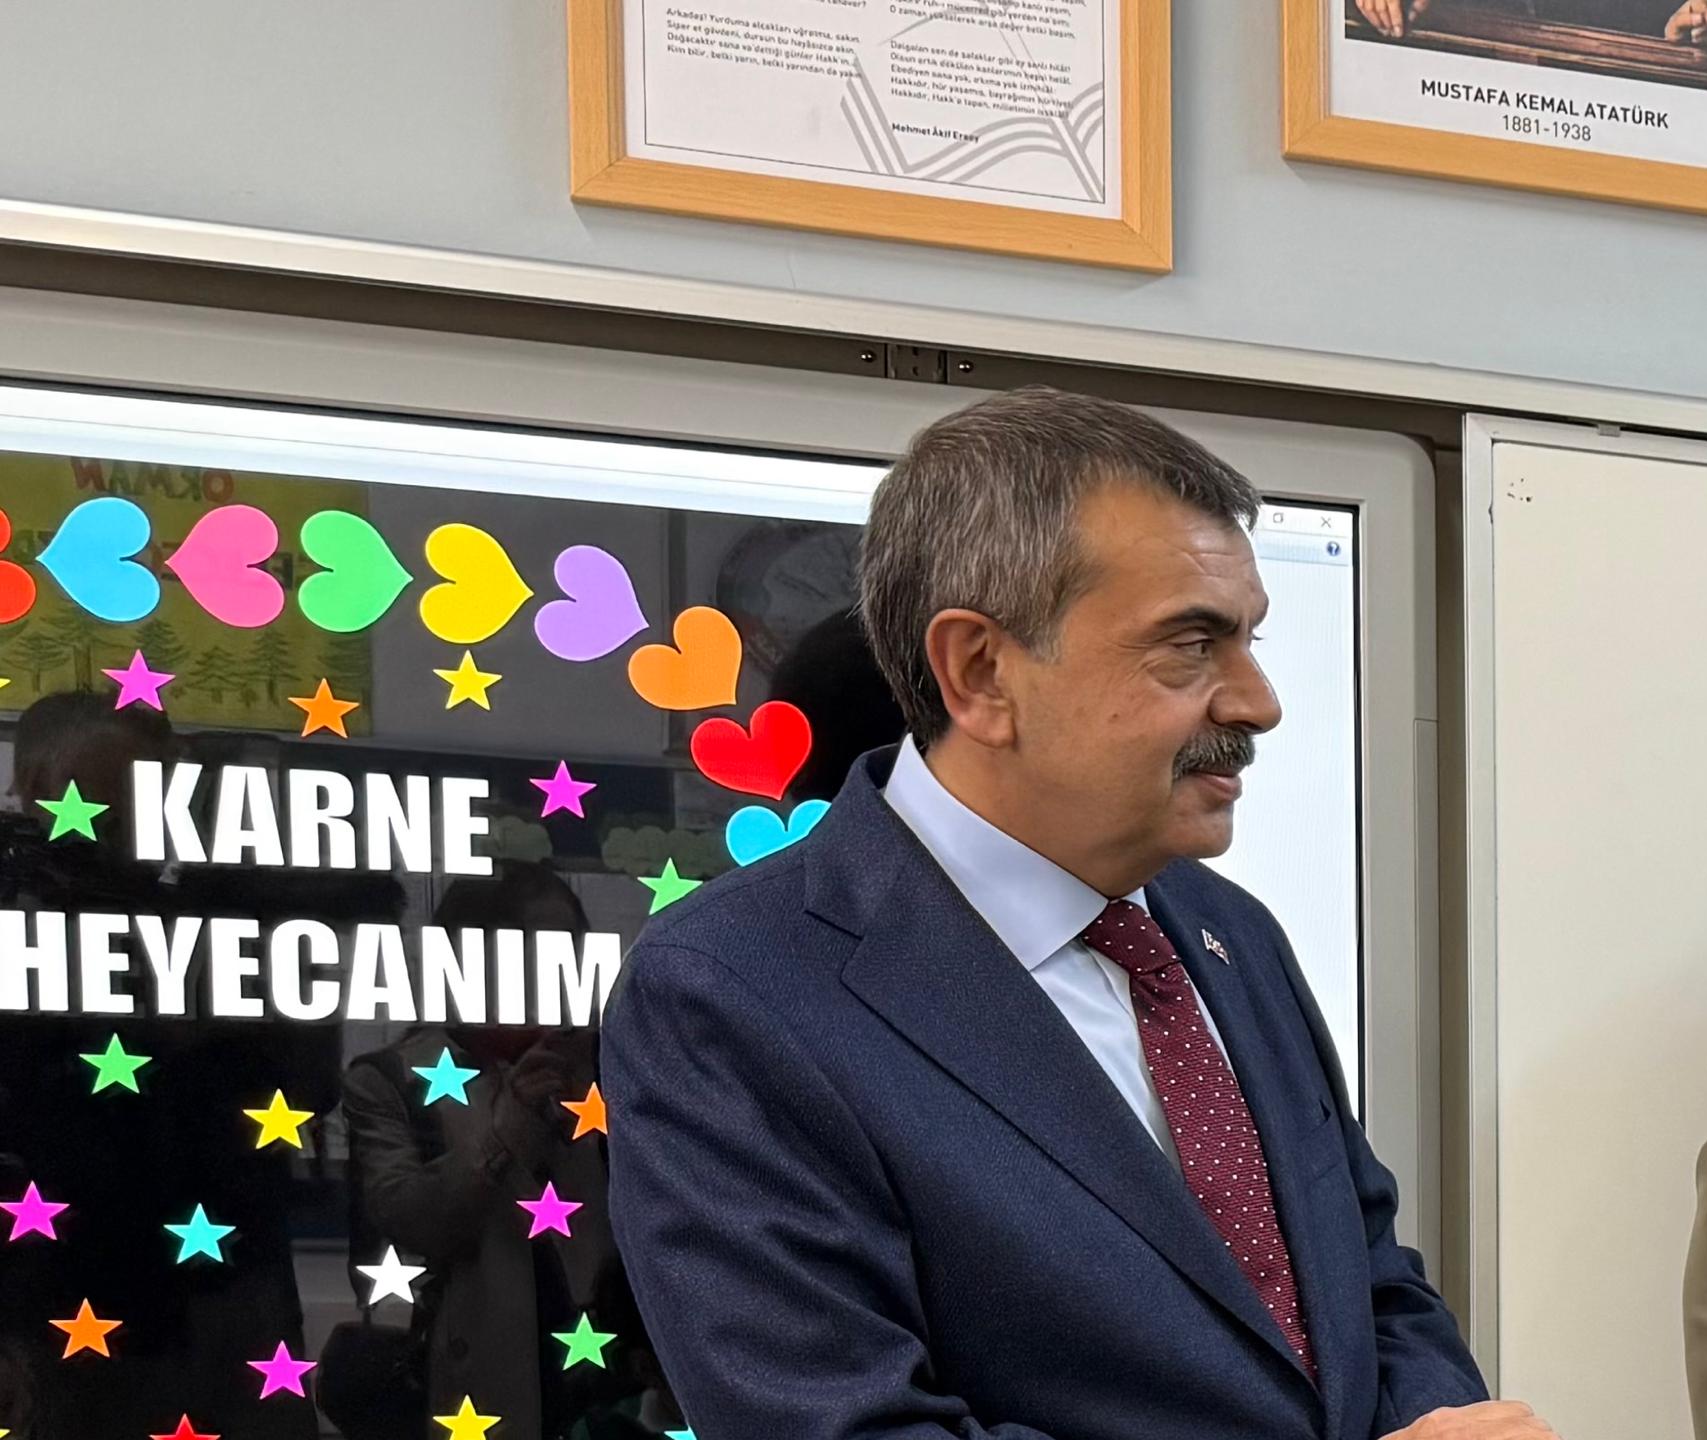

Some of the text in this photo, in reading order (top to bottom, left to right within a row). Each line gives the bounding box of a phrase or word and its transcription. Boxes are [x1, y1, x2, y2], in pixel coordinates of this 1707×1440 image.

[1421, 78, 1669, 129] MUSTAFA KEMAL ATATÜRK
[1502, 114, 1592, 141] 1881-1938
[133, 759, 494, 877] KARNE
